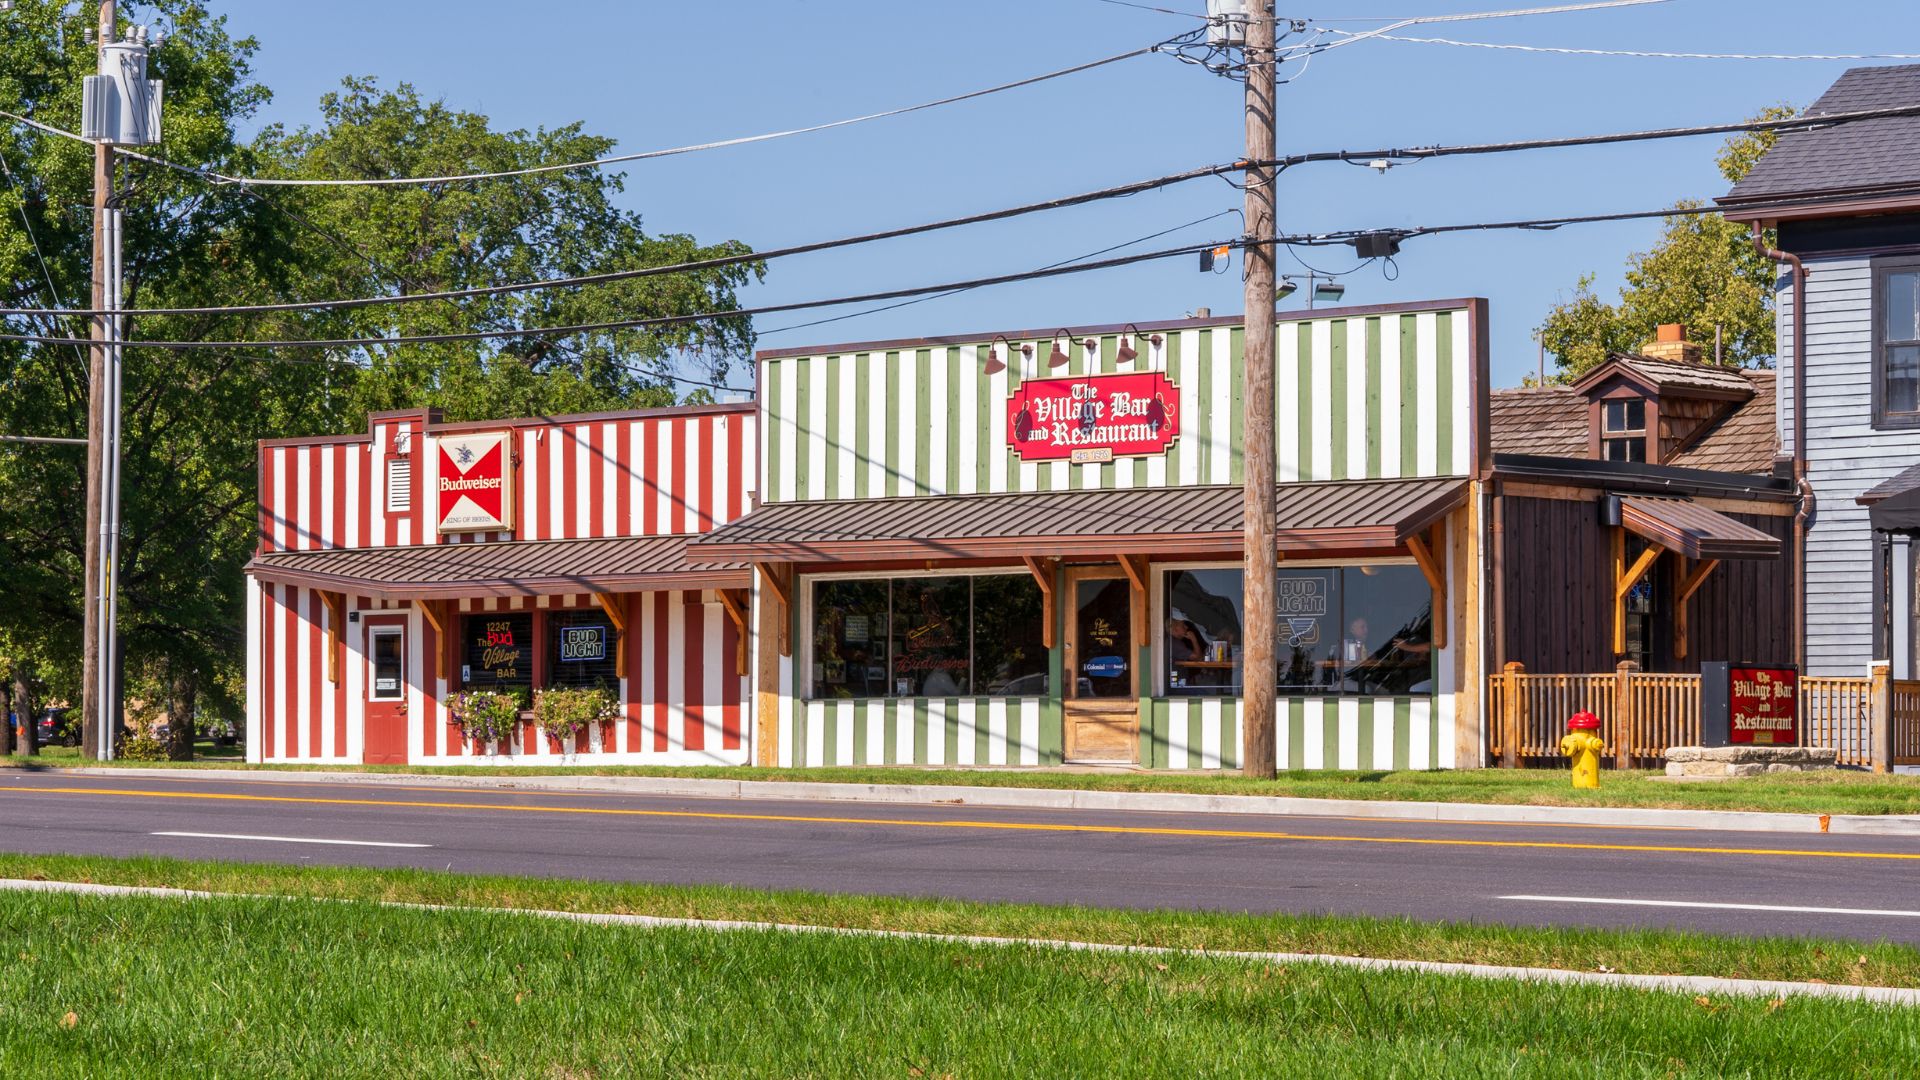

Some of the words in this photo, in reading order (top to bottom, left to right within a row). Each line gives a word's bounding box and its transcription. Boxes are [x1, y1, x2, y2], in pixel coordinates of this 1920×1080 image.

[1071, 383, 1098, 400] The
[1034, 396, 1105, 424] Village
[1110, 391, 1152, 421] Bar
[1028, 427, 1049, 442] and
[1051, 419, 1159, 447] Restaurant
[440, 475, 501, 491] Budweiser
[446, 516, 462, 524] KING
[1280, 580, 1317, 596] BUD
[486, 622, 511, 632] 12247
[477, 638, 491, 647] The
[486, 631, 513, 647] Bud
[568, 629, 598, 644] BUD
[563, 642, 603, 657] LIGHT
[482, 647, 520, 669] Village
[496, 668, 516, 678] BAR
[1756, 671, 1771, 684] The
[1733, 680, 1771, 700] Village
[1773, 681, 1793, 700] Bar
[1758, 701, 1771, 712] and
[1734, 713, 1793, 730] Restaurant
